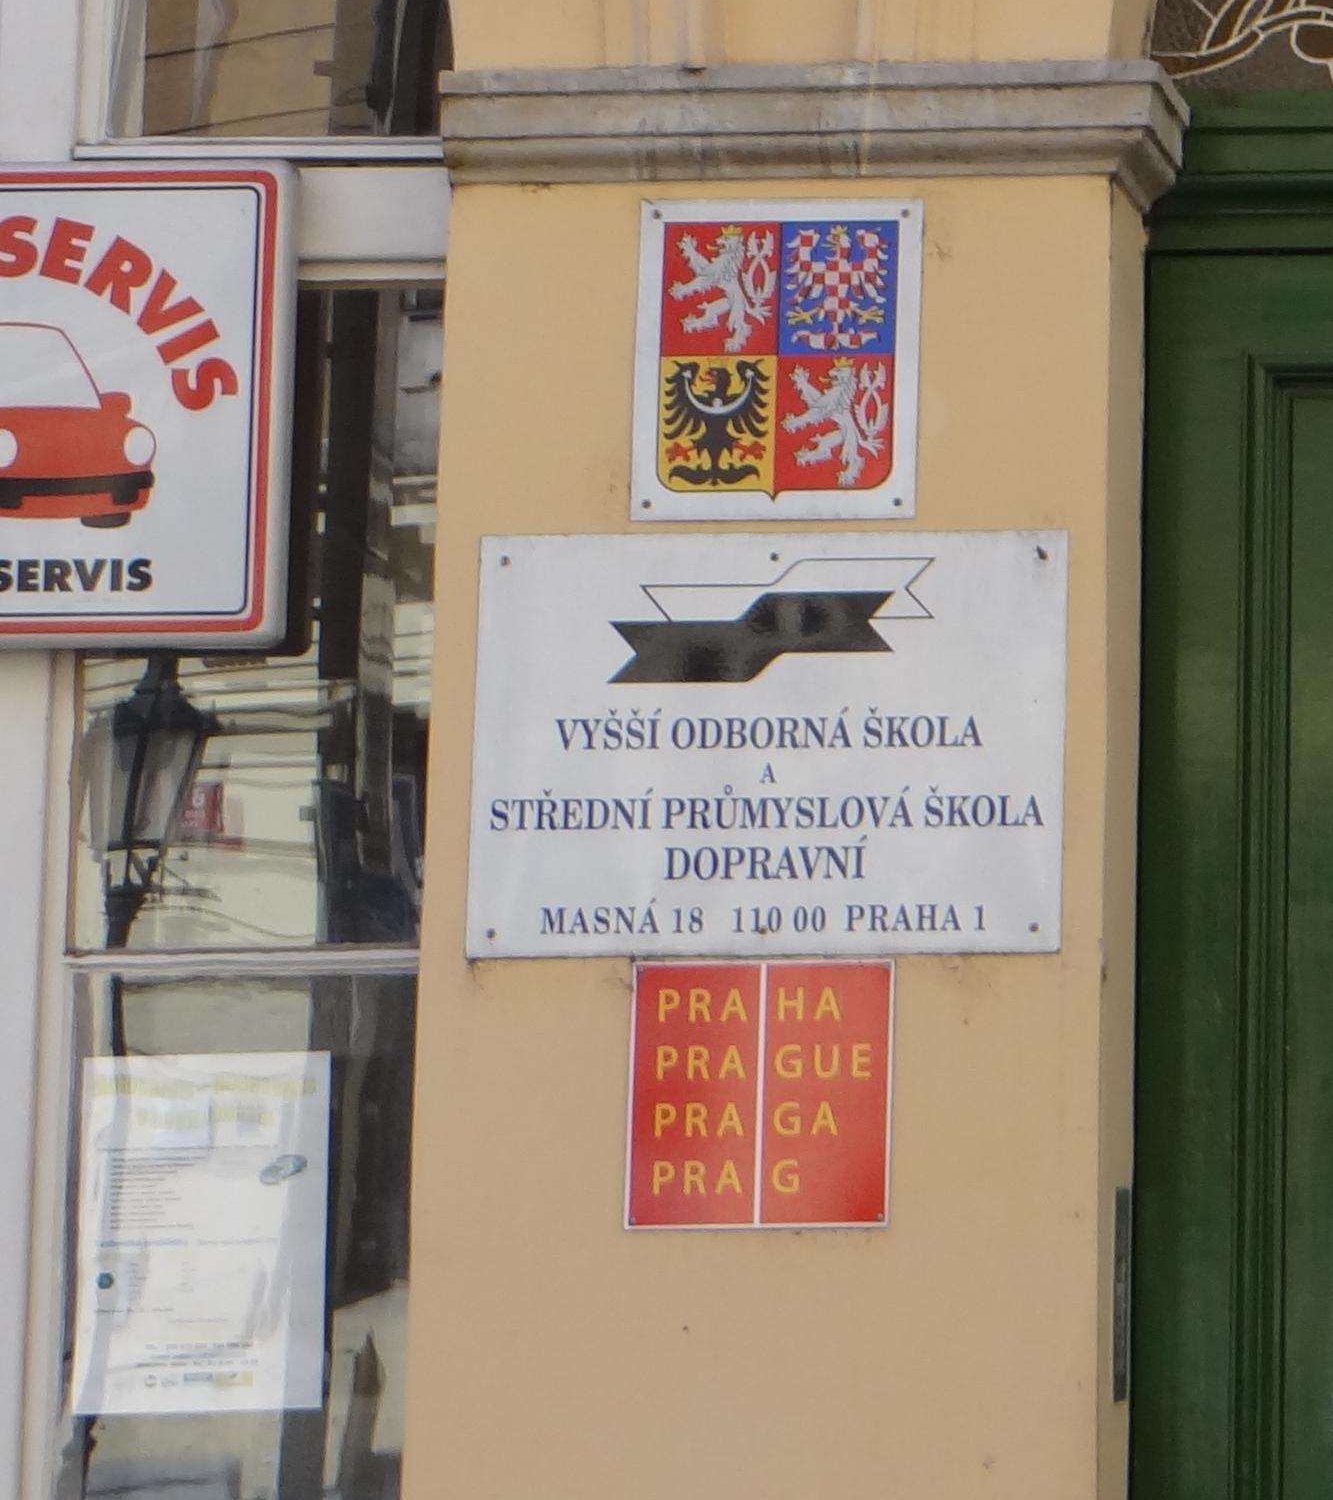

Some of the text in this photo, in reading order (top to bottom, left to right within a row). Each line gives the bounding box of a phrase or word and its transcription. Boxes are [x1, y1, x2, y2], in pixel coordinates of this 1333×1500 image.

[0, 215, 239, 411] SERVIS
[555, 707, 983, 750] VYŠŠÍ ODBORNÁ ŠKOLA
[759, 762, 777, 785] A
[490, 783, 1044, 831] STŘEDNÍ PRŮMYSLOVÁ ŠKOLA
[663, 835, 867, 881] DOPRAVNÍ
[540, 898, 986, 934] MASNÁ 18 110 00 PRAHA 1
